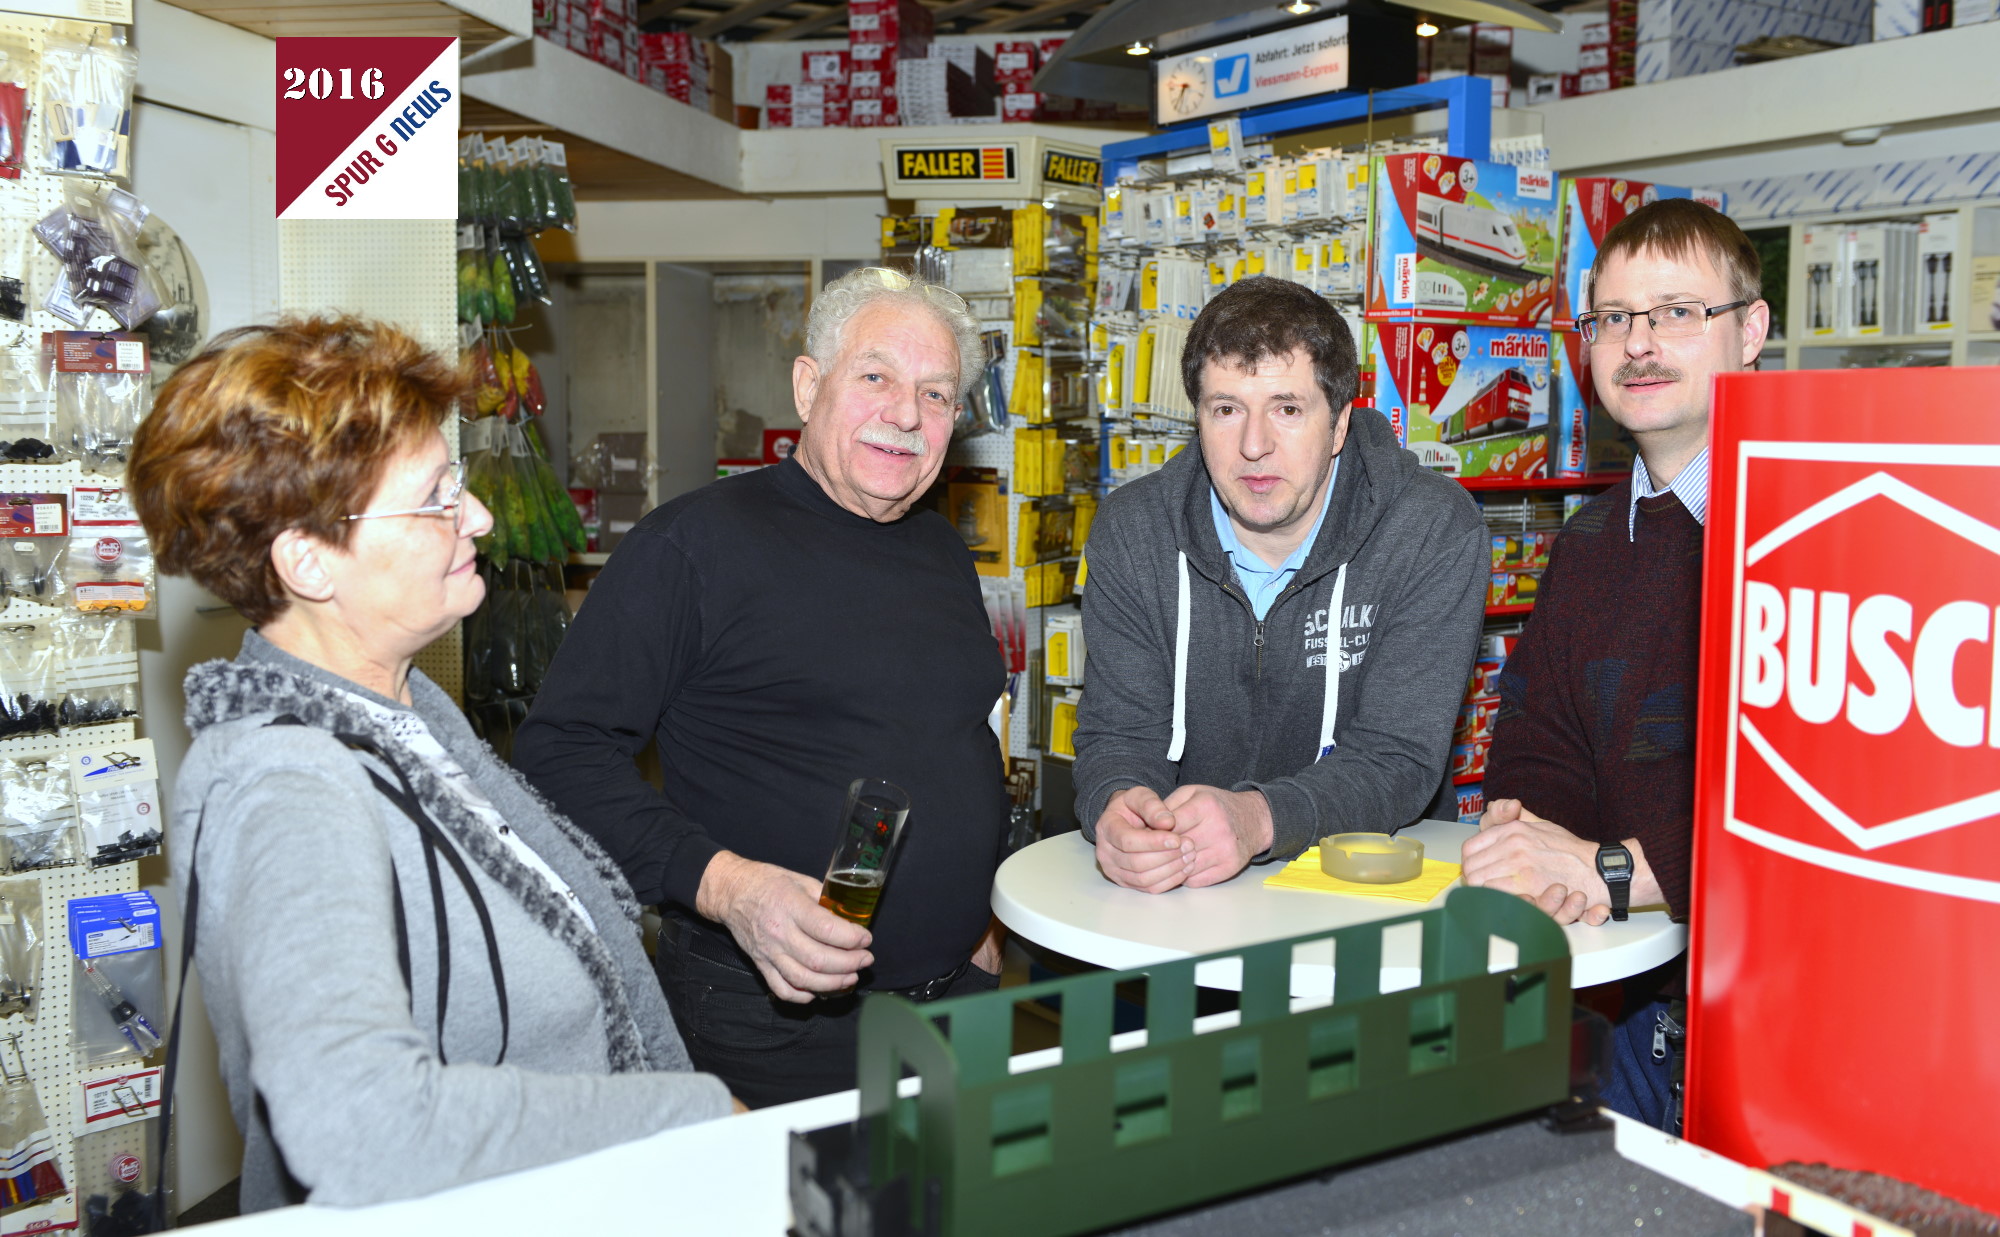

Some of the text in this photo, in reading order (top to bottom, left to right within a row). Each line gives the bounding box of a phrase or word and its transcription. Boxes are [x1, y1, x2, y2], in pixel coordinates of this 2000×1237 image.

[1255, 47, 1290, 64] Abfahrt:
[1291, 41, 1315, 57] Jetzt
[1255, 62, 1339, 88] Viessmann-Express
[903, 152, 976, 177] FALLER
[1047, 154, 1098, 184] FALLER
[1461, 168, 1475, 184] 3+
[1401, 257, 1410, 300] märklin
[1454, 338, 1467, 351] 3+
[1490, 334, 1548, 358] märklin
